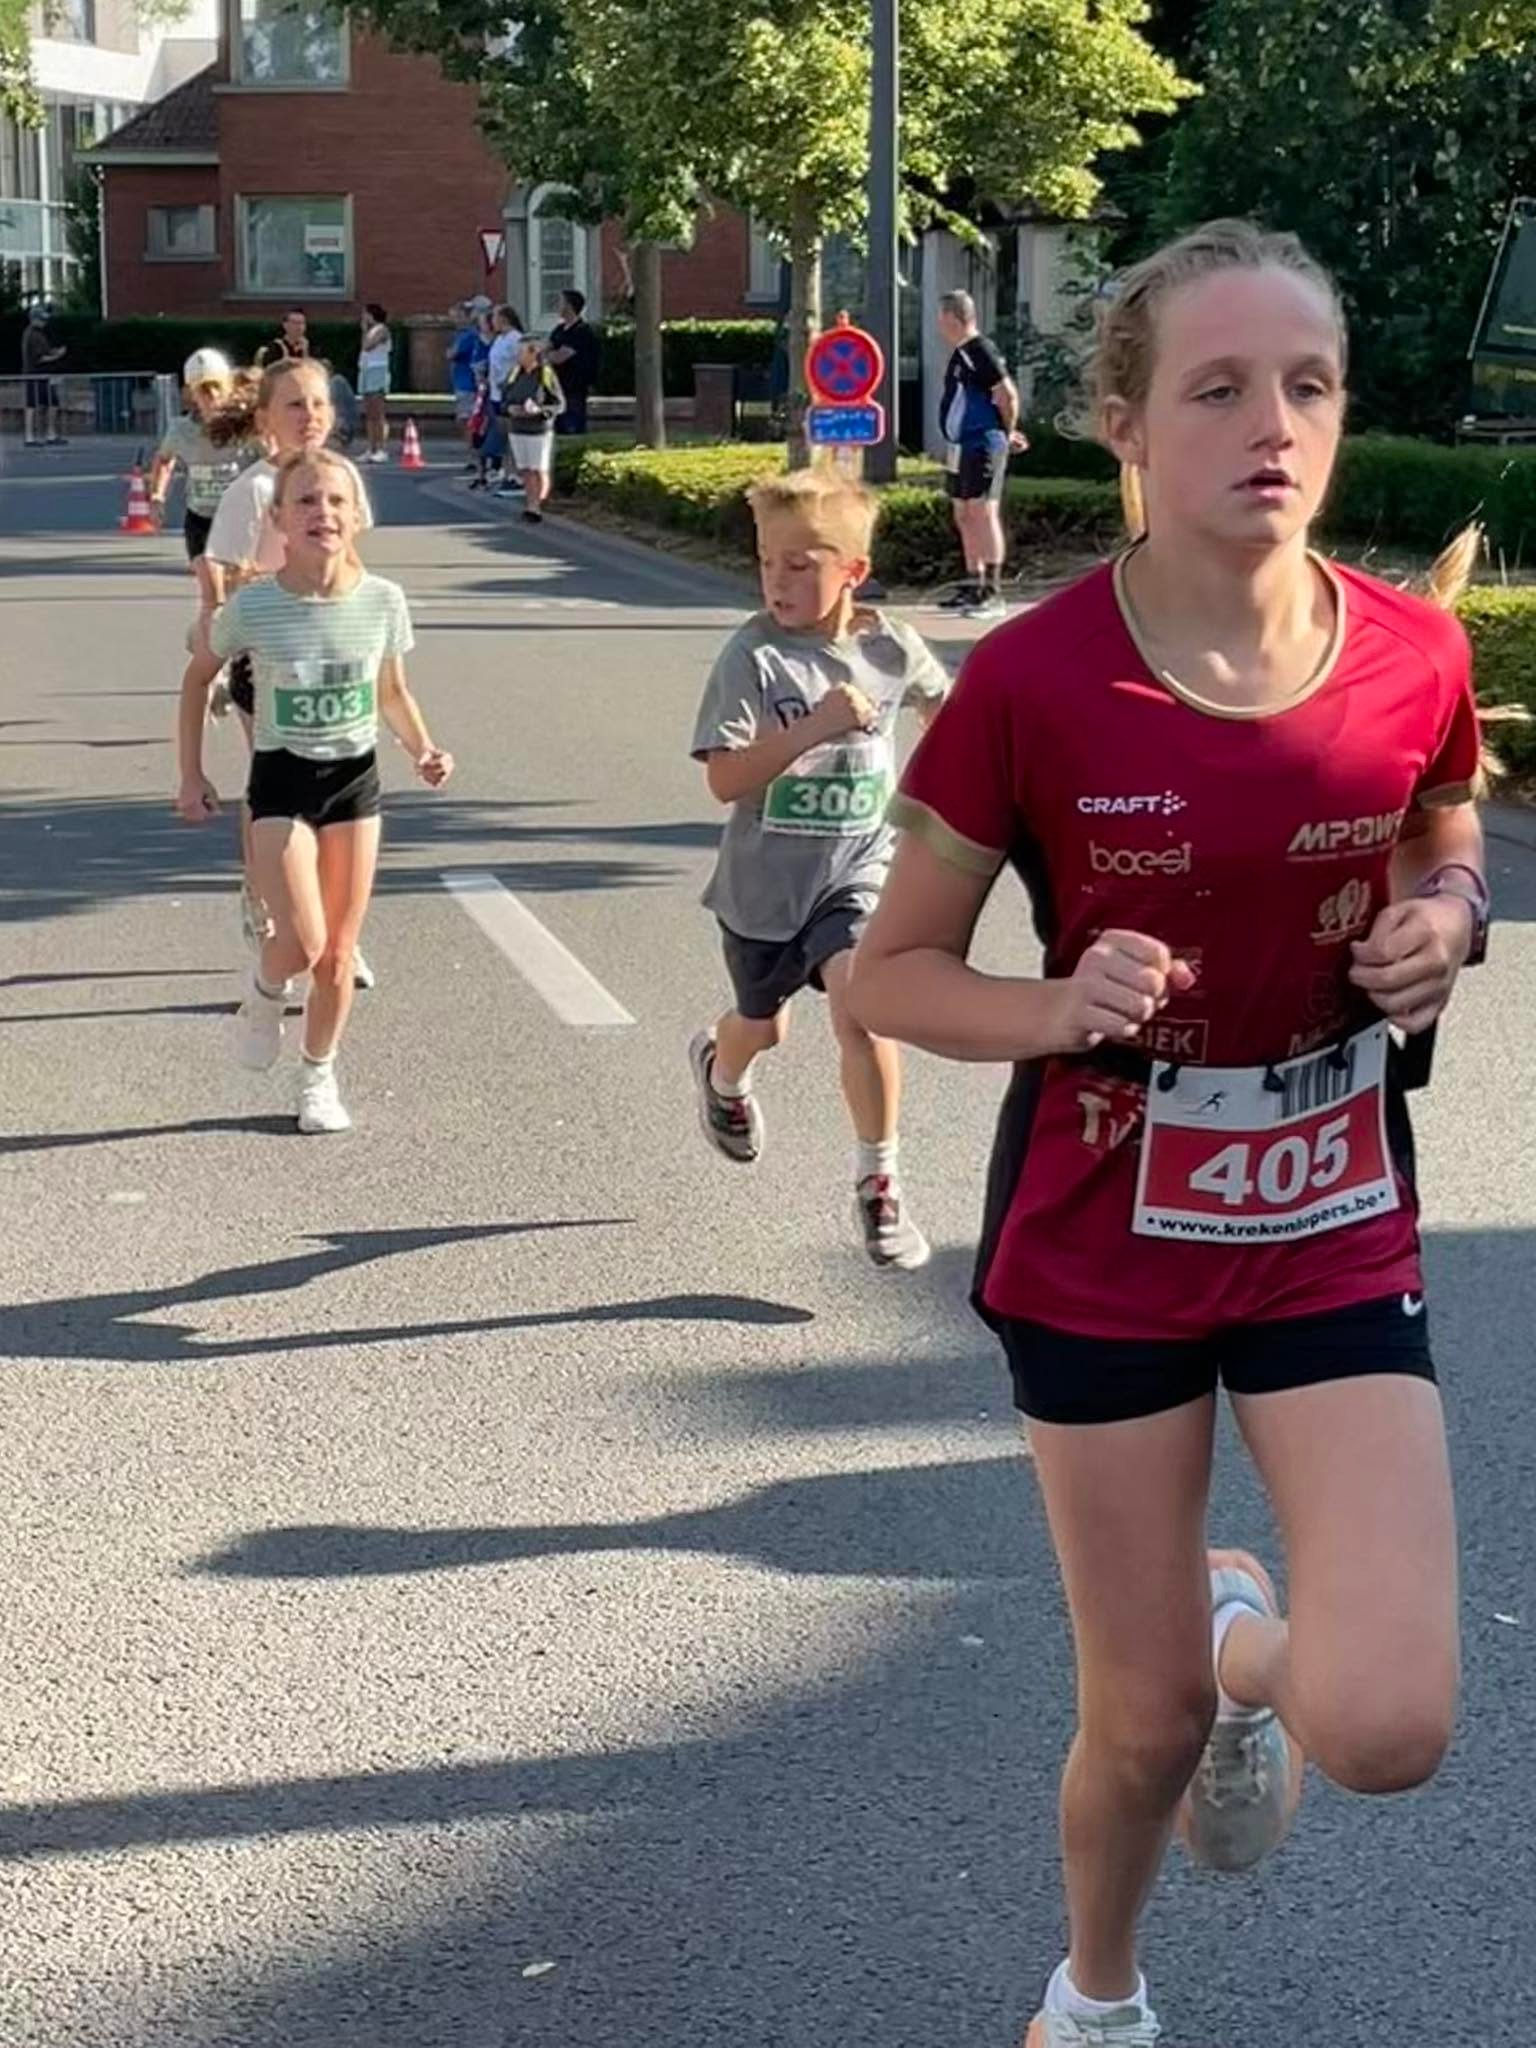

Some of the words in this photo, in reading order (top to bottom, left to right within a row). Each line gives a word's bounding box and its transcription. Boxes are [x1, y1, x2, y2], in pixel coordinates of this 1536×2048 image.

[292, 690, 362, 723] 303
[788, 780, 875, 817] 306
[1077, 795, 1162, 814] CRAFT
[1188, 1113, 1350, 1206] 405
